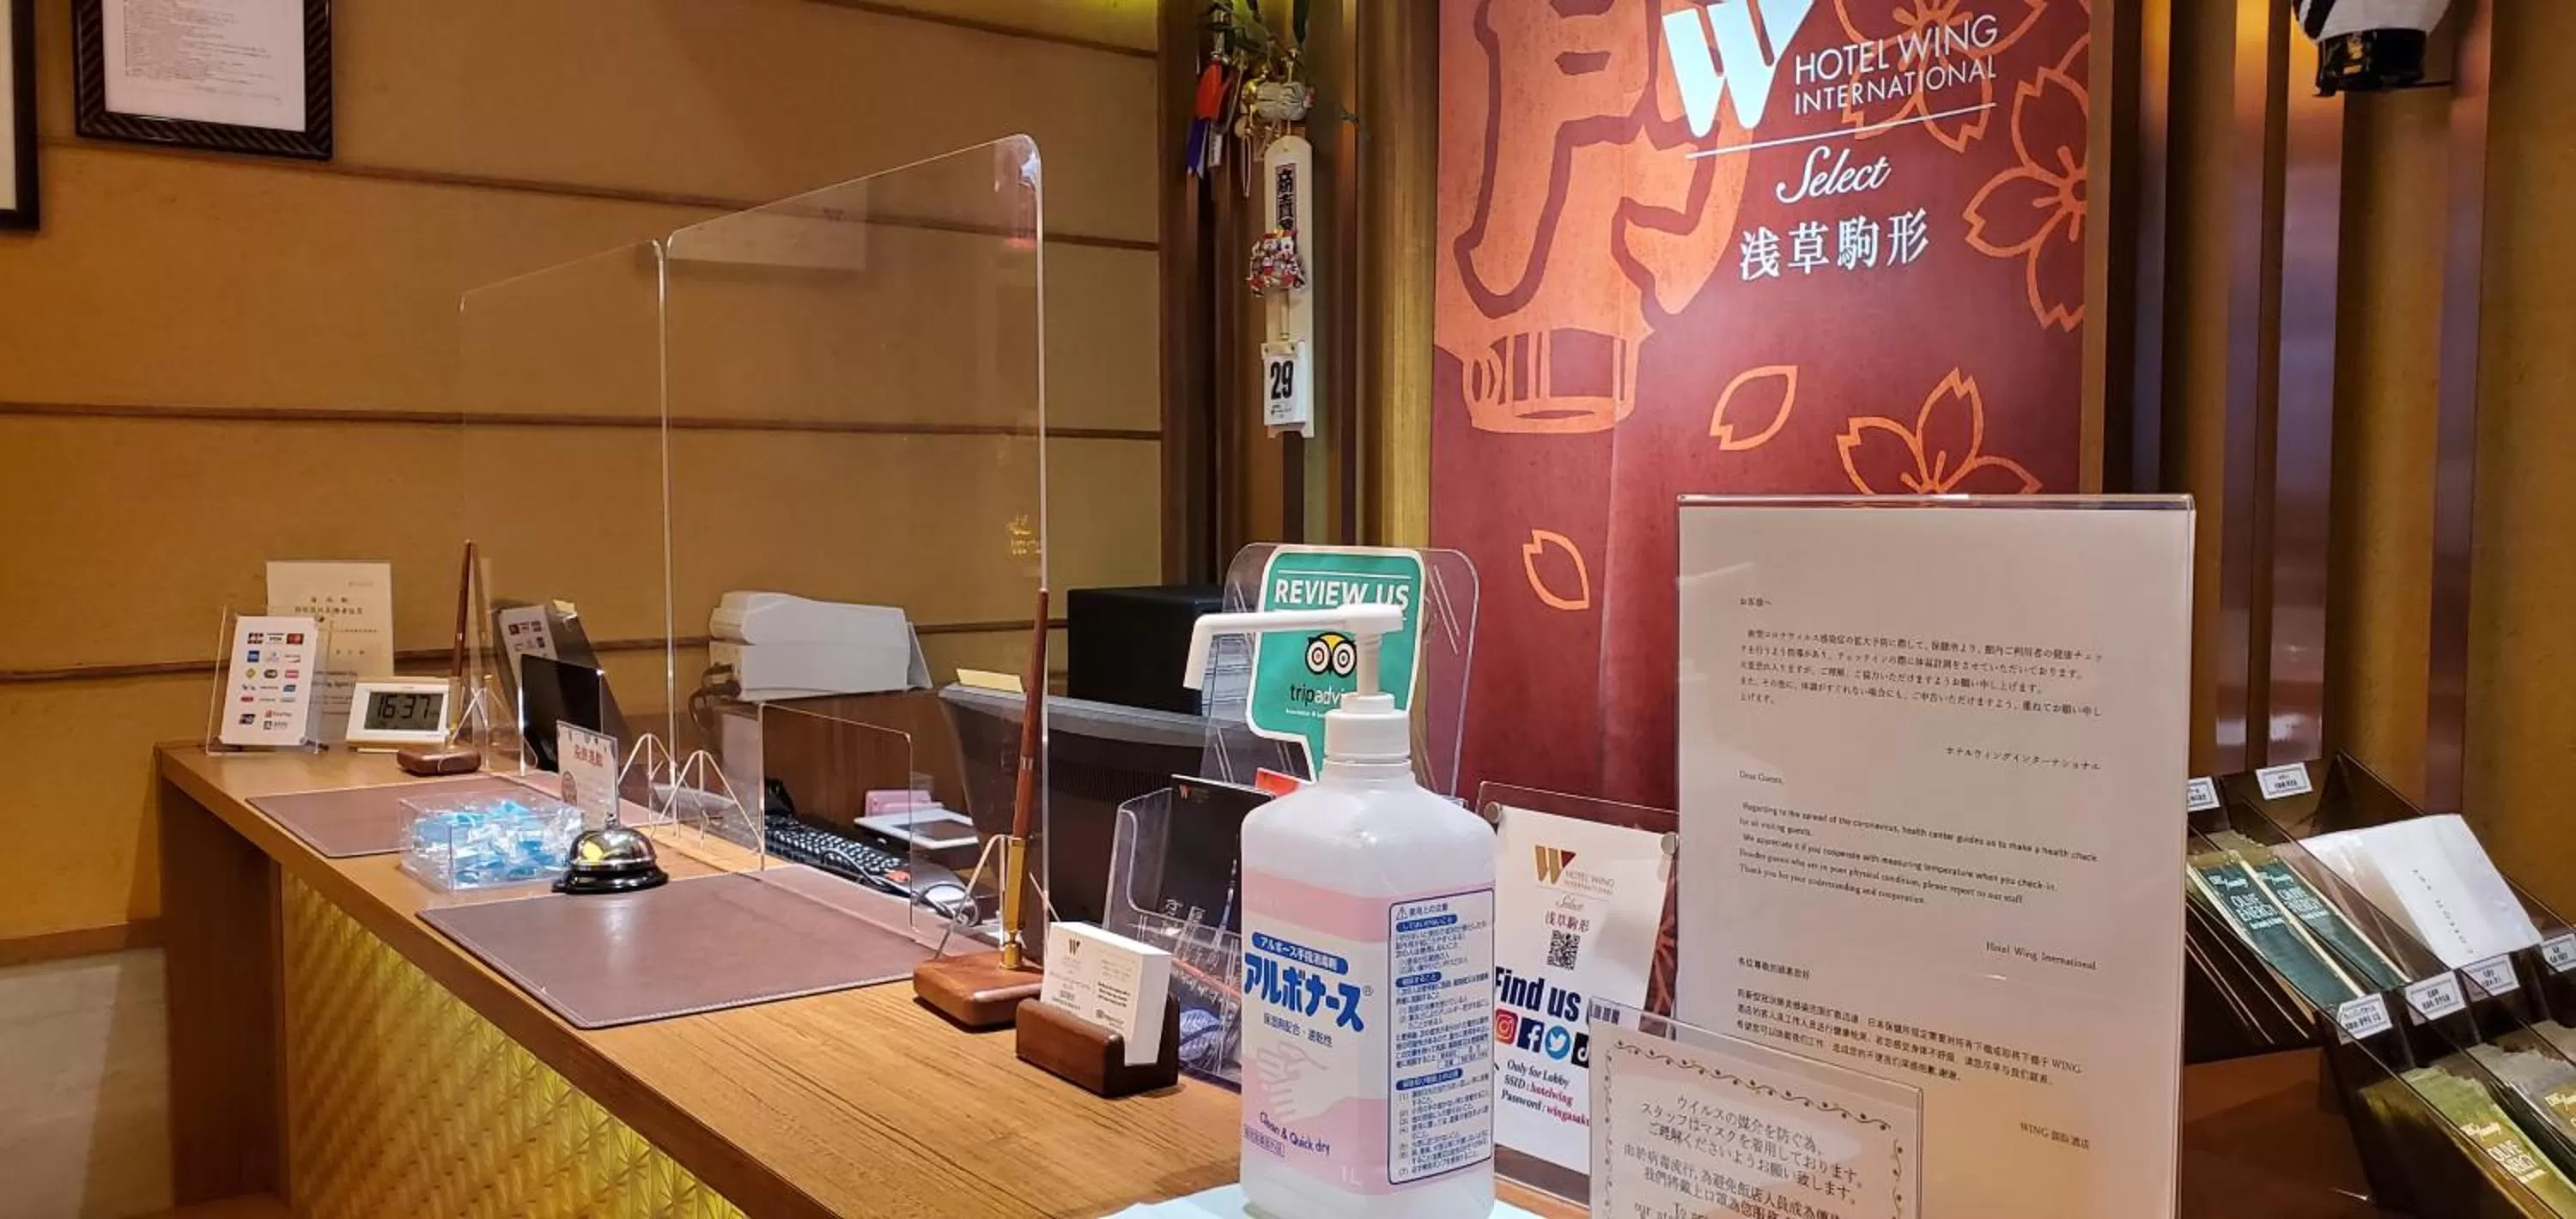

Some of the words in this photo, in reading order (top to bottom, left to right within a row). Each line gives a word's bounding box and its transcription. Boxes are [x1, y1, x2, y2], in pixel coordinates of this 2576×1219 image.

[1795, 39, 1888, 85] HOTEL
[1896, 14, 1998, 64] WING
[1795, 55, 1997, 116] INTERNATIONAL
[1776, 146, 1893, 204] Select
[1740, 207, 1930, 282] 浅草駒形
[1270, 361, 1293, 401] 29
[1274, 579, 1369, 606] REVIEW
[1376, 584, 1409, 610] US
[378, 694, 431, 719] 16:37
[1291, 684, 1346, 707] tripadv
[1902, 824, 1928, 838] health
[1985, 940, 2011, 955] Hotel
[2014, 947, 2038, 962] Wing
[2041, 951, 2098, 972] International
[1244, 952, 1365, 1032] アルボナース
[1496, 967, 1546, 1012] Find
[1547, 987, 1582, 1022] us
[1506, 1059, 1528, 1076] Only
[1528, 1064, 1542, 1077] for
[1543, 1070, 1571, 1089] Lobby
[2050, 1057, 2083, 1075] WING
[1501, 1089, 1543, 1111] Password
[1530, 1081, 1574, 1107] hotelwing
[1260, 1112, 1280, 1136] Clean
[1281, 1125, 1288, 1143] &
[1289, 1128, 1315, 1152] Quick
[1315, 1138, 1332, 1157] dry
[2020, 1121, 2050, 1139] WING
